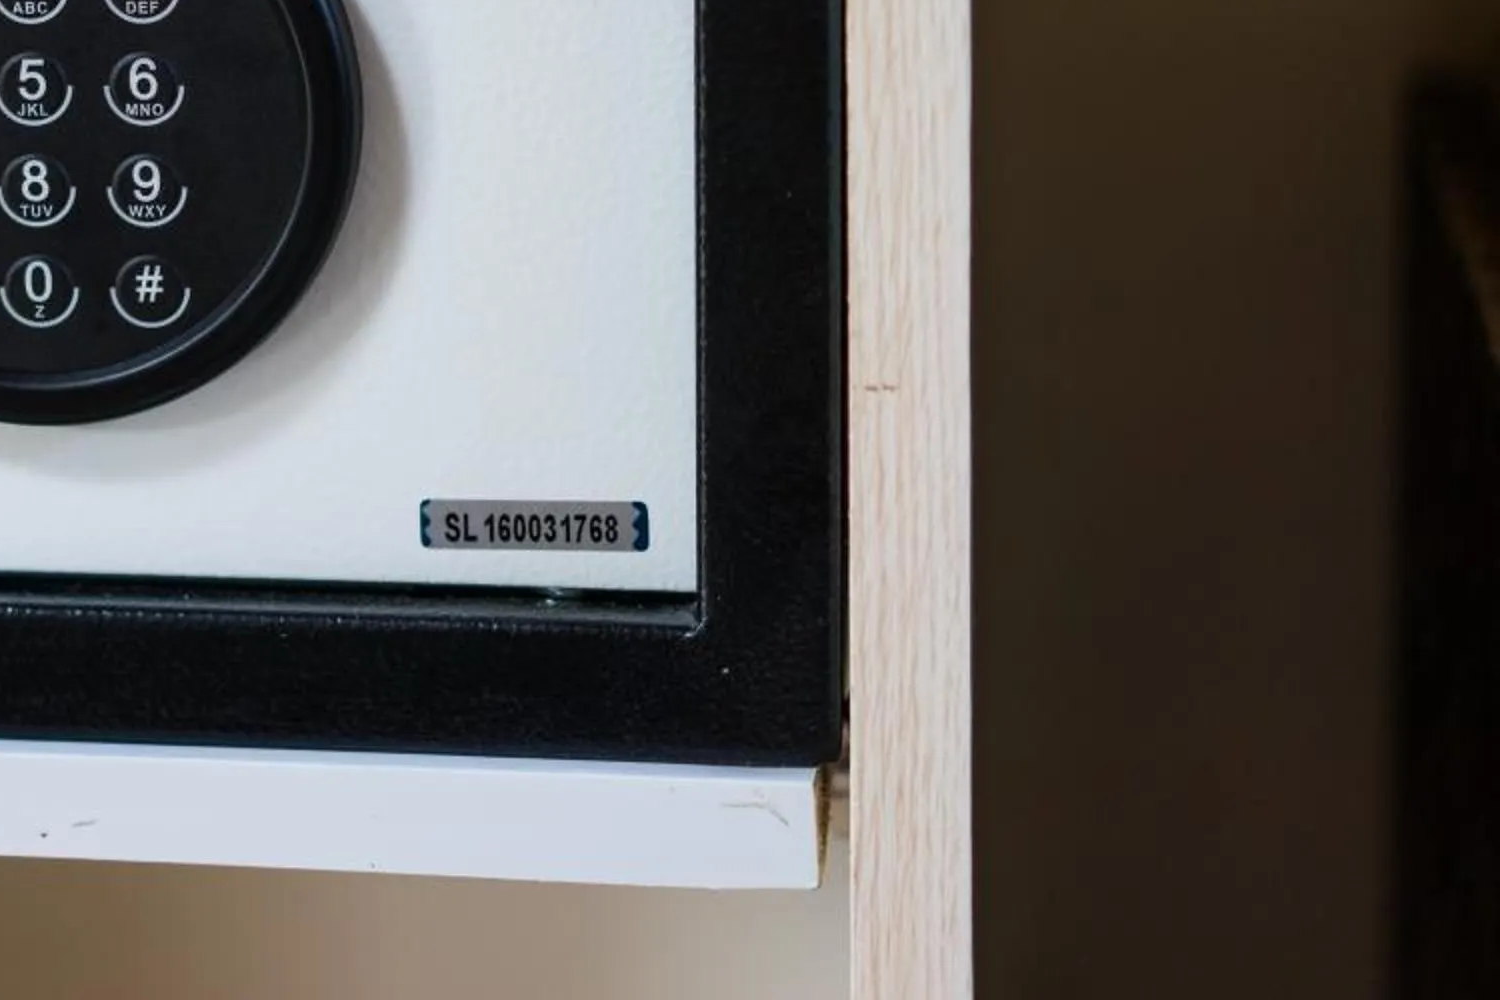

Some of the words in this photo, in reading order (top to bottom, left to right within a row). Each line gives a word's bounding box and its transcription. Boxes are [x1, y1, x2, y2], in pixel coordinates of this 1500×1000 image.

[13, 1, 47, 15] ABC
[125, 1, 158, 14] DEF
[19, 58, 47, 101] 5
[129, 57, 158, 101] 6
[17, 103, 48, 117] JKL
[125, 103, 164, 116] MNO
[21, 159, 50, 202] 8
[132, 159, 161, 203] 9
[19, 204, 53, 217] TUV
[128, 204, 166, 217] WXY
[24, 260, 53, 303] 0
[135, 265, 164, 303] #
[444, 512, 479, 543] SL
[483, 513, 619, 545] 160031768
